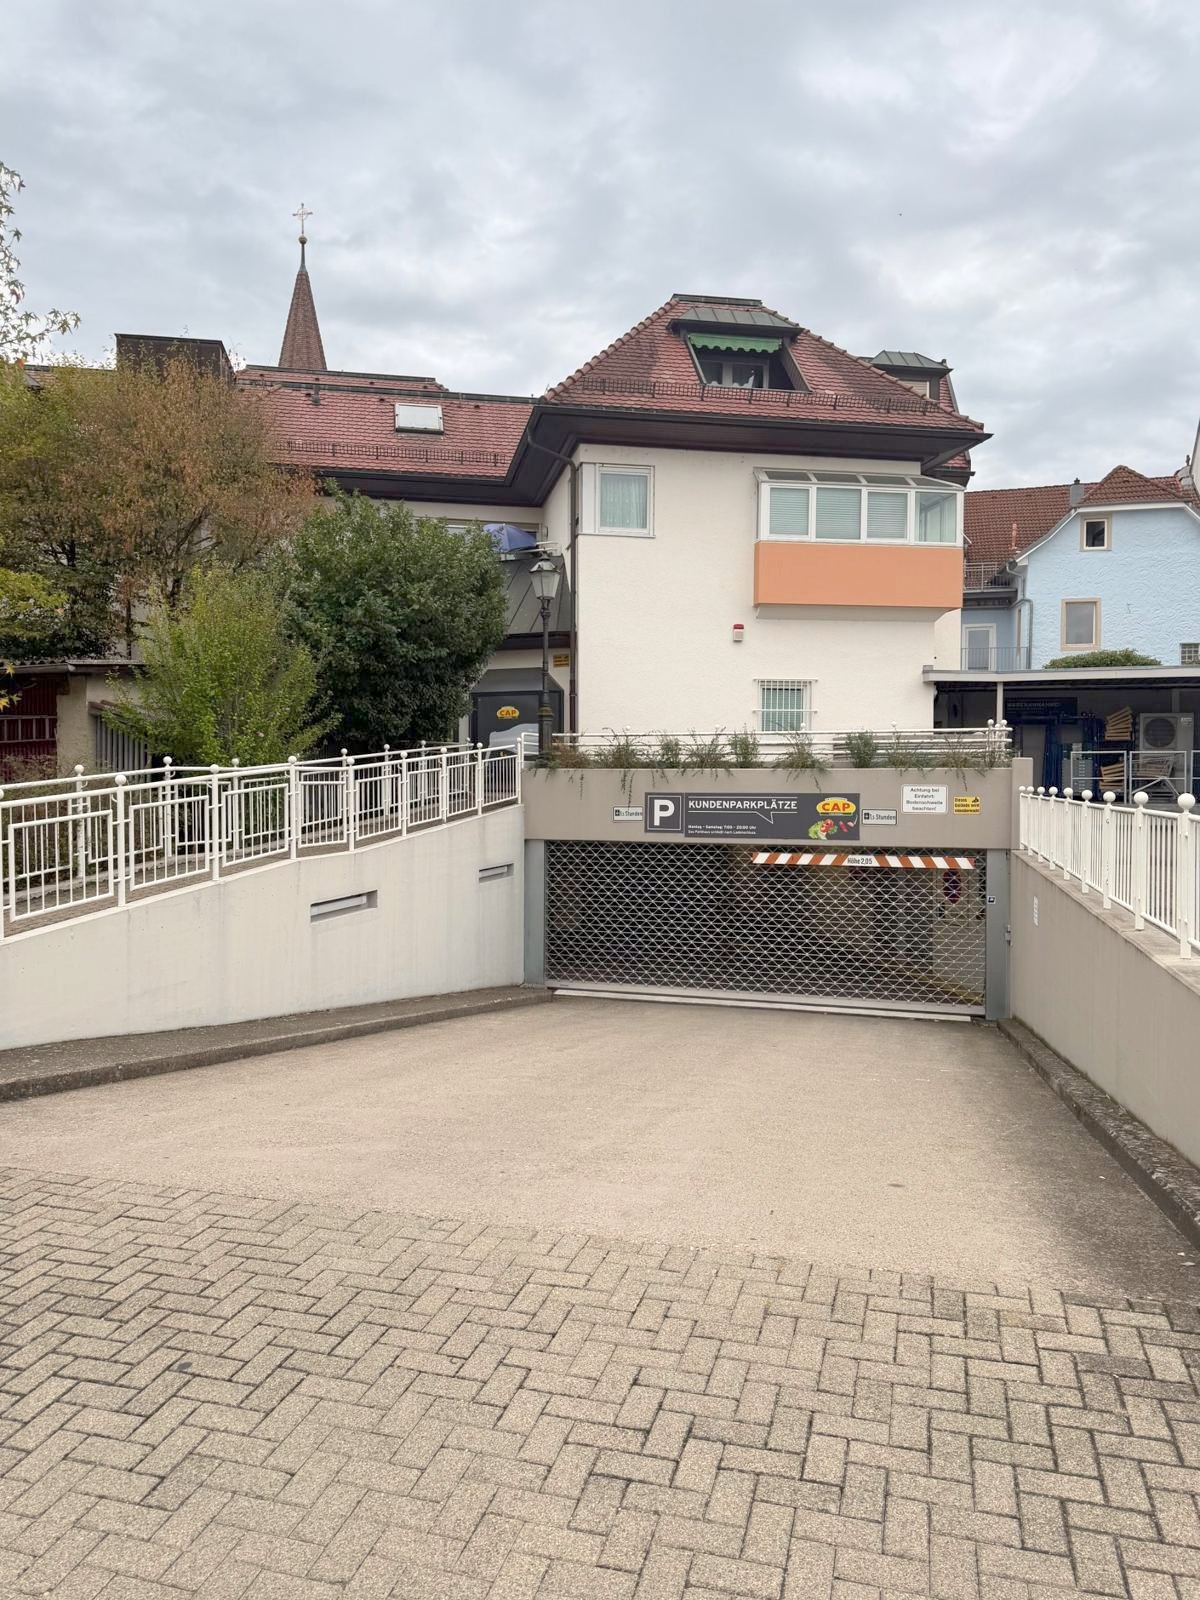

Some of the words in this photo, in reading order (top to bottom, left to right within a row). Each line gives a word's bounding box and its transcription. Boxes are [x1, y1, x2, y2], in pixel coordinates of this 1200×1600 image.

[688, 799, 798, 810] KUNDENPARKPLÄTZE
[821, 802, 851, 811] CAP
[653, 799, 675, 826] P
[876, 813, 896, 821] Stunden
[847, 857, 860, 865] Höhe
[860, 857, 873, 866] 2,05
